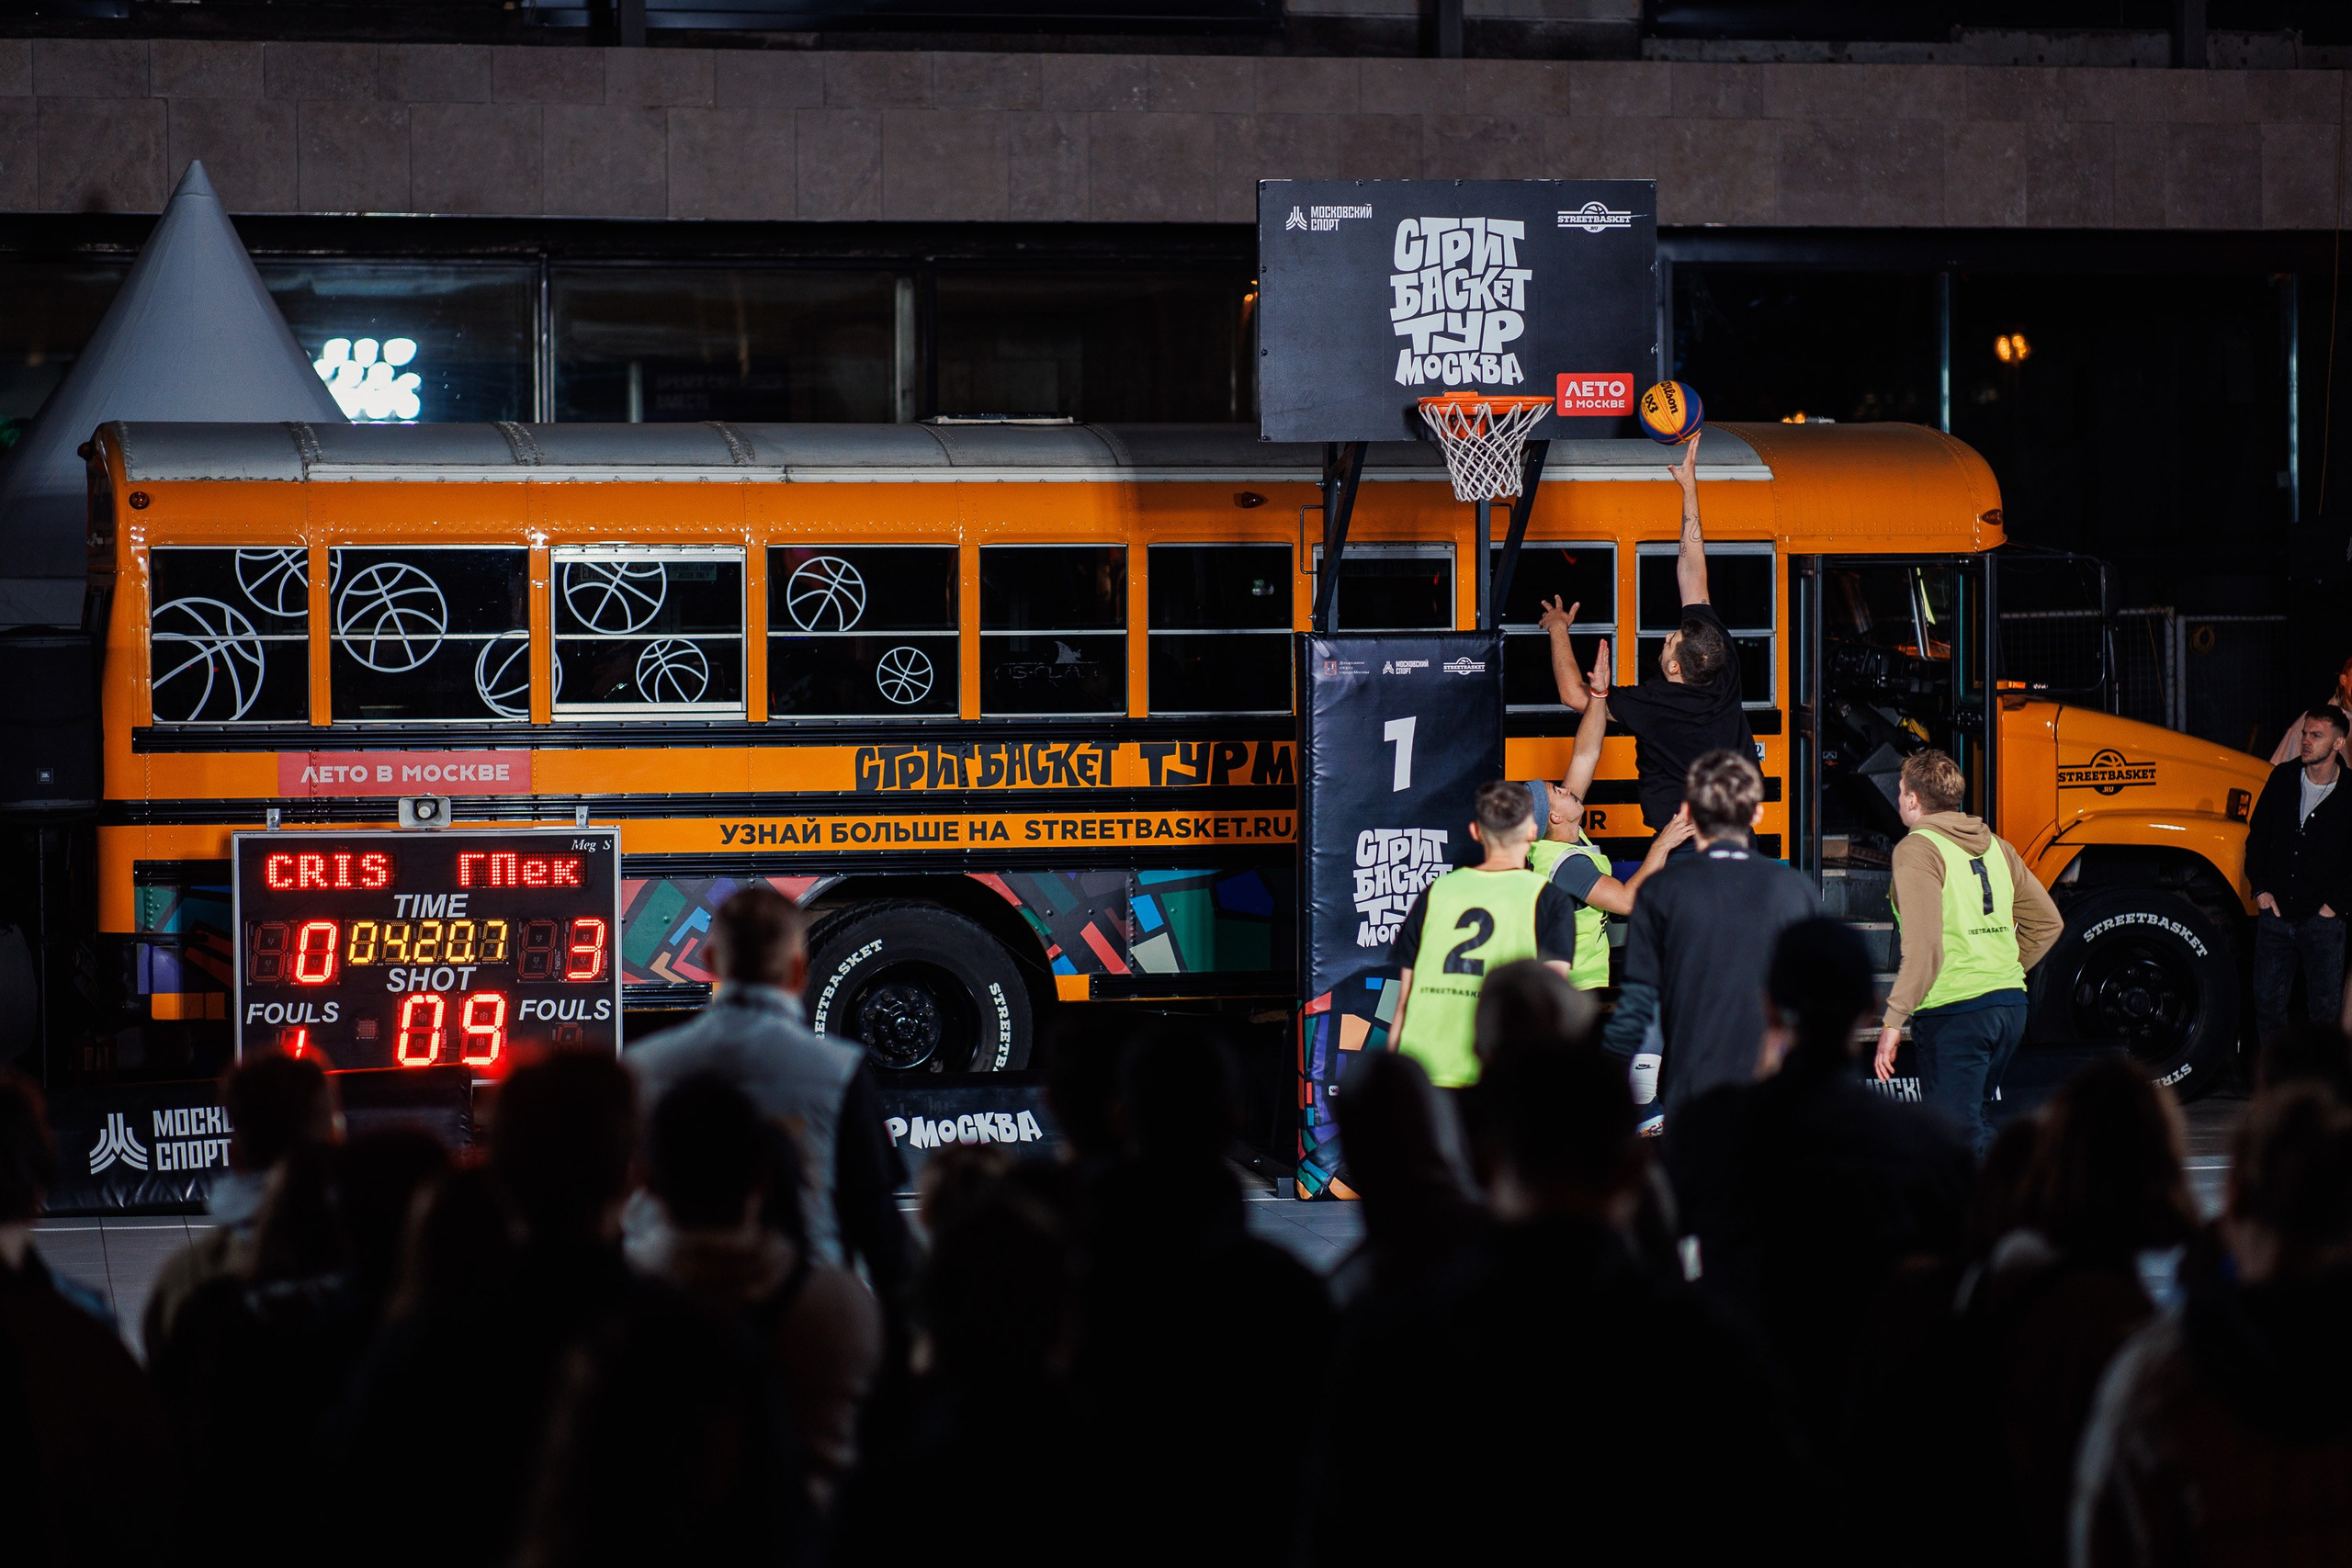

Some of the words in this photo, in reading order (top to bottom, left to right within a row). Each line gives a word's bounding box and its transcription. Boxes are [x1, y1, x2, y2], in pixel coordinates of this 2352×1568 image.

[1310, 204, 1373, 219] МОСКОВСКИЙ
[1311, 219, 1340, 231] СПОРТ
[1557, 215, 1631, 223] STREETBASKET
[1394, 217, 1525, 276] СТРИТ
[1390, 266, 1532, 321] БАСКЕТ
[1393, 310, 1525, 355] ТУР
[1395, 348, 1525, 386] МОСКВА
[1565, 381, 1626, 398] ЛЕТО
[1565, 400, 1573, 409] В
[1576, 400, 1625, 409] МОСКВЕ
[1396, 667, 1411, 675] СПОРТ
[855, 744, 975, 791] СТРИТ
[976, 742, 1120, 788] БАСКЕТ
[1140, 742, 1249, 787] ТУР
[1250, 741, 1297, 784] М
[1384, 716, 1417, 793] 1
[300, 765, 368, 784] ЛЕТО
[377, 765, 393, 783] В
[402, 763, 510, 783] МОСКВЕ
[2058, 769, 2156, 782] STREETBASKET
[720, 817, 821, 845] УЗНАЙ
[831, 822, 959, 844] БОЛЬШЕ
[968, 821, 1010, 842] НА
[1355, 828, 1449, 869] СТРИТ
[266, 853, 388, 889] CRIS
[1969, 856, 1996, 916] 1
[393, 893, 469, 919] TIME
[296, 921, 338, 983] 0
[566, 919, 605, 979] 3
[1442, 907, 1496, 976] 2
[2083, 912, 2208, 958] STREETBASKET
[386, 966, 477, 993] SHOT
[245, 1001, 340, 1025] FOULS
[518, 999, 612, 1021] FOULS
[397, 993, 507, 1066] 09
[910, 1110, 1043, 1149] МОСКВА
[155, 1138, 232, 1171] СПОРТ
